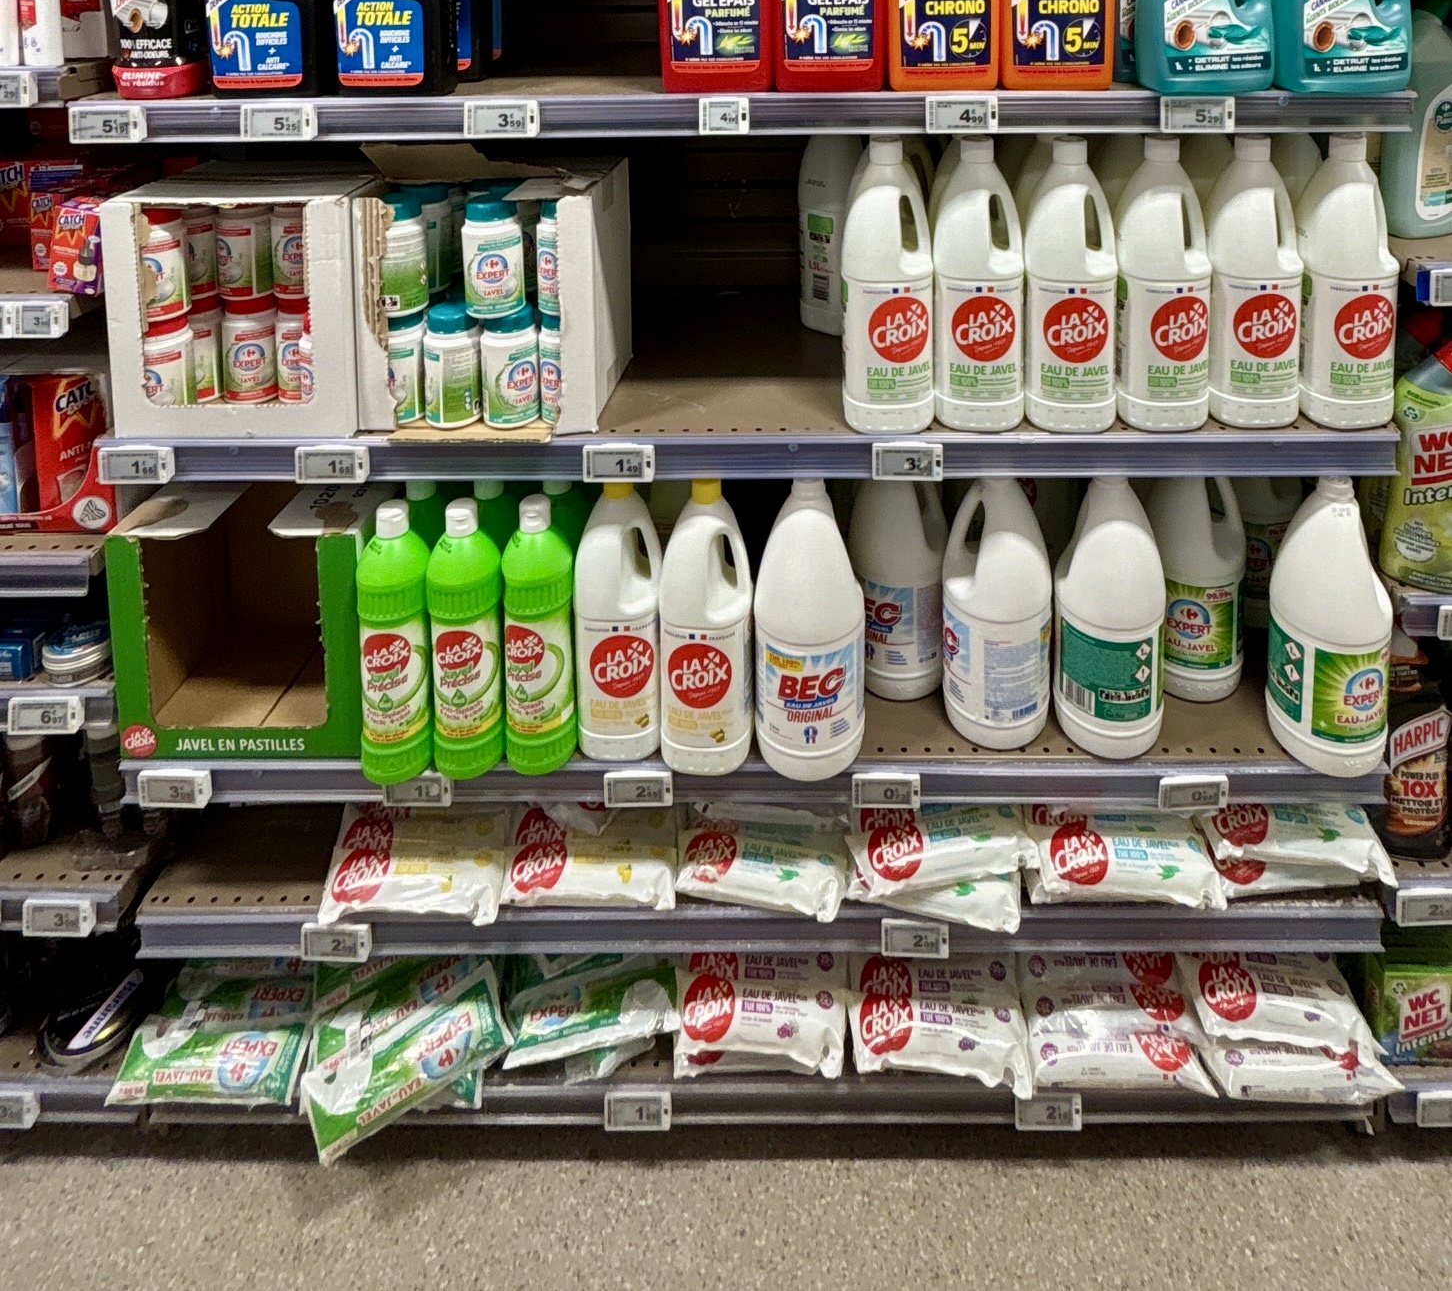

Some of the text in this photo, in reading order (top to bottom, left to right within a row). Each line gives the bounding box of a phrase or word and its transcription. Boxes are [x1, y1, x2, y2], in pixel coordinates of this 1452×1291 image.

[231, 4, 270, 13] ACTION
[356, 2, 393, 11] ACTION
[705, 6, 751, 17] PARFUMÉ
[819, 5, 865, 17] PARFUMÉ
[925, 0, 985, 15] CHRONO
[231, 12, 289, 28] TOTALE
[356, 11, 412, 25] TOTALE
[58, 214, 85, 226] CATCH
[476, 268, 510, 281] EXPERT
[886, 313, 905, 328] LA
[969, 311, 989, 326] LA
[1060, 313, 1079, 329] LA
[1169, 313, 1188, 328] LA
[1252, 308, 1269, 324] LA
[1353, 310, 1370, 326] LA
[873, 314, 927, 348] CROIX
[955, 316, 1013, 345] CROIX
[1047, 315, 1107, 347] CROIX
[1155, 314, 1208, 346] CROIX
[1237, 313, 1295, 344] CROIX
[1338, 315, 1393, 345] CROIX
[867, 361, 930, 377] EAU DE JAVEL
[950, 363, 1017, 375] EAU DE JAVEL
[1041, 363, 1109, 377] EAU DE JAVEL
[1230, 359, 1296, 372] EAU DE JAVEL
[1331, 362, 1352, 373] EAU
[1354, 362, 1370, 373] DE
[1167, 617, 1212, 635] EXPERT
[446, 645, 460, 656] LA
[511, 639, 523, 650] LA
[365, 649, 411, 668] CROIX
[373, 648, 389, 659] LA
[437, 646, 481, 666] CROIX
[606, 649, 622, 665] LA
[594, 651, 652, 684] CROIX
[682, 661, 702, 675] LA
[671, 663, 728, 691] CROIX
[778, 663, 846, 700] BEC
[786, 707, 832, 723] ORIGINAL
[175, 738, 305, 752] JAVEL EN PASTILLES
[1393, 717, 1443, 757] HARPIC
[1401, 772, 1423, 780] POWER
[1401, 780, 1438, 797] 10X
[880, 833, 897, 848] LA
[1063, 836, 1080, 853] LA
[872, 834, 922, 869] CROIX
[1054, 842, 1106, 873] CROIX
[512, 851, 567, 880] CROIX
[333, 860, 391, 892] CROIX
[1204, 975, 1252, 1003] CROIX
[1408, 988, 1440, 1011] WC
[684, 996, 733, 1026] CROIX
[872, 1003, 889, 1017] LA
[1404, 1004, 1445, 1030] NET
[862, 1005, 910, 1039] CROIX
